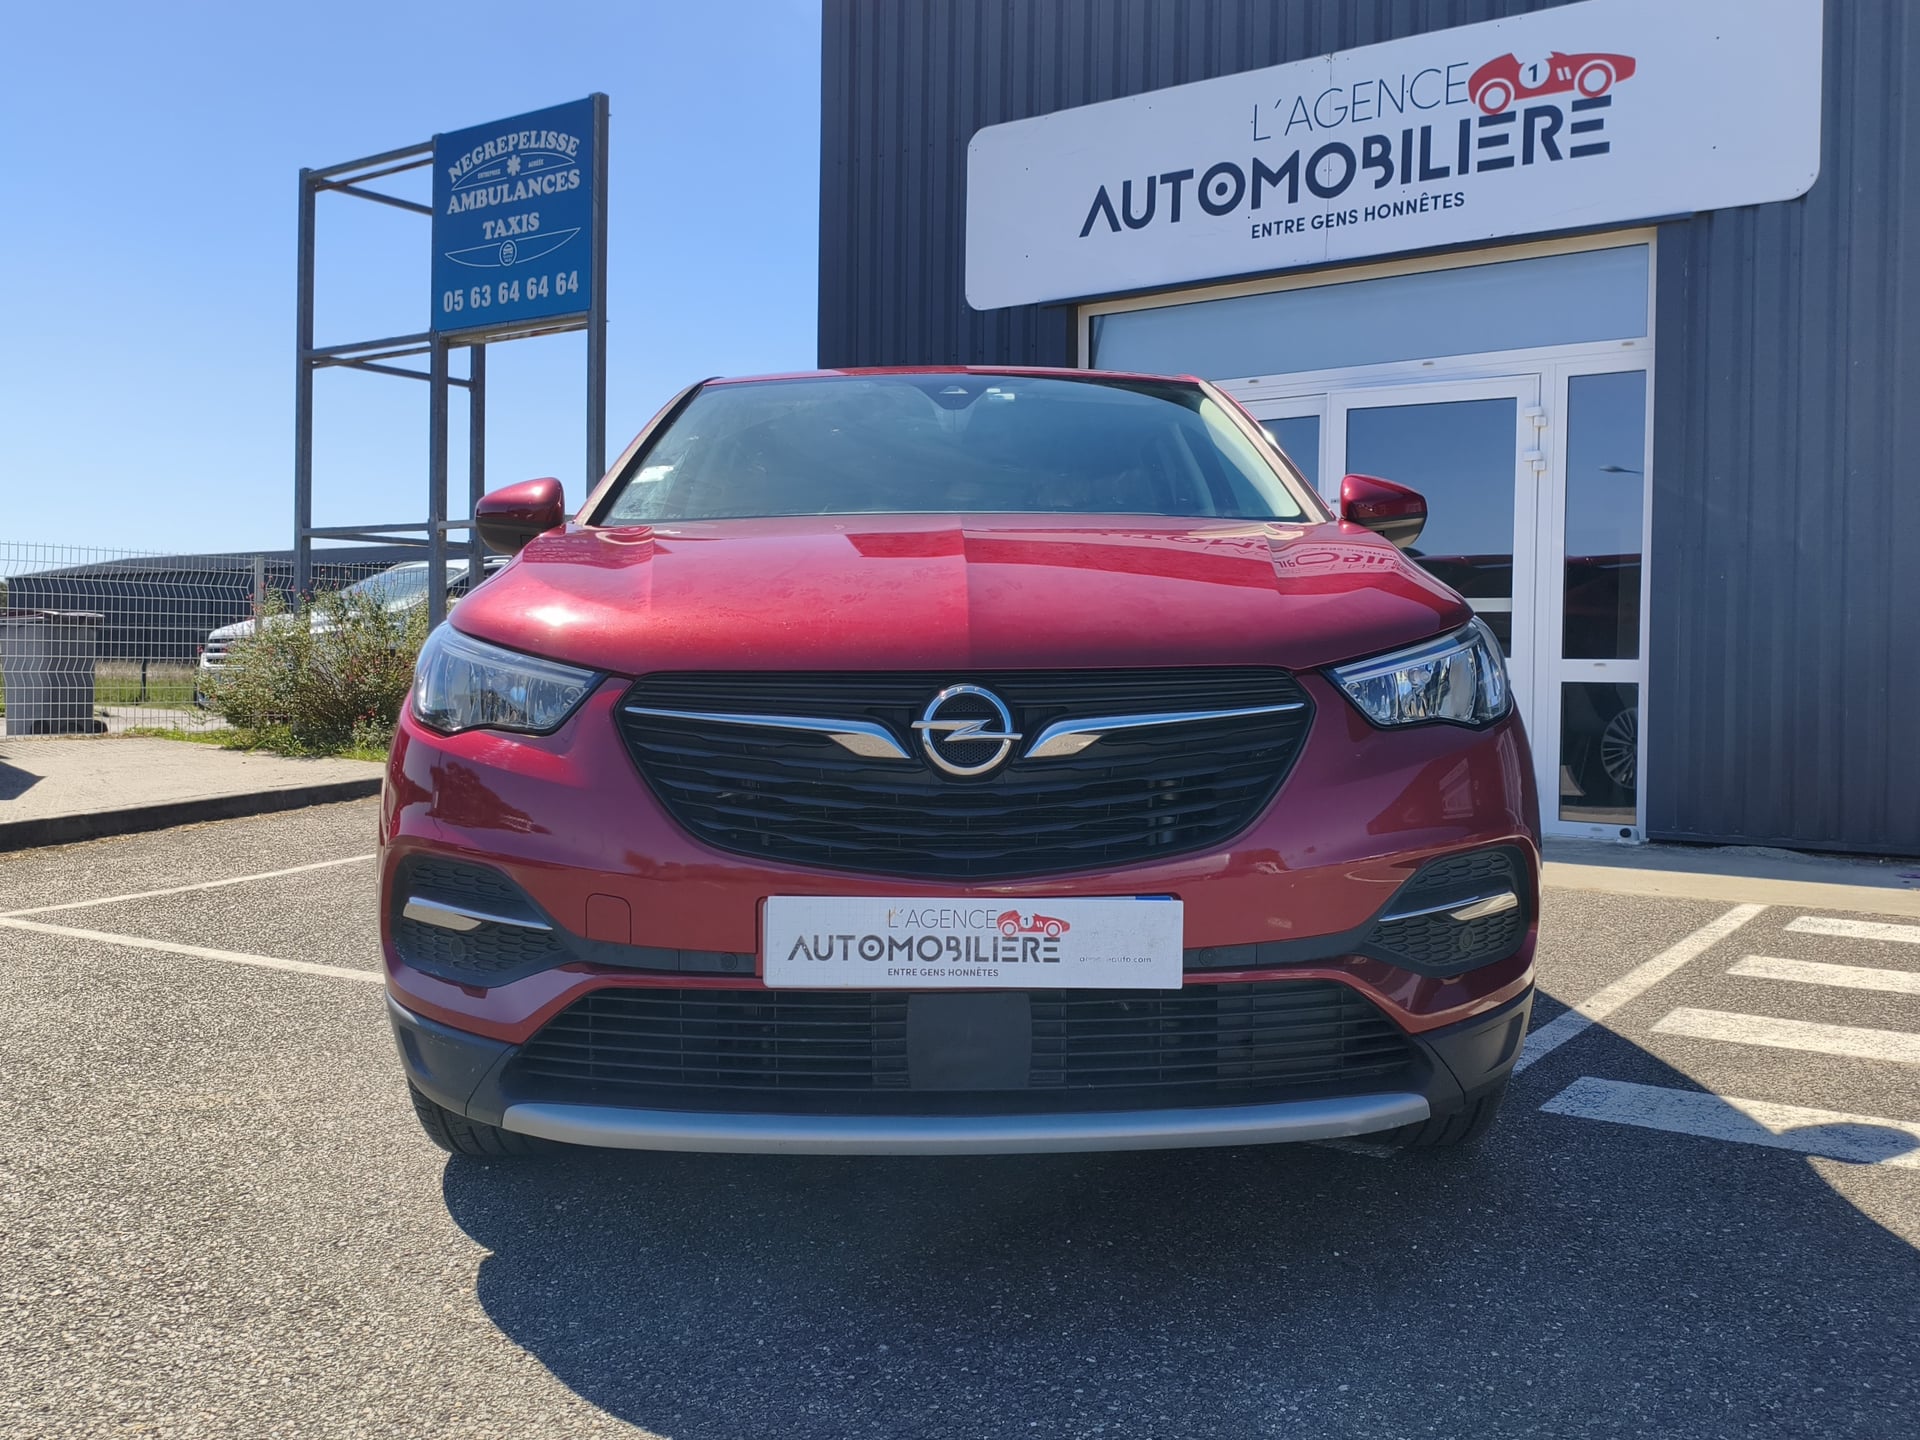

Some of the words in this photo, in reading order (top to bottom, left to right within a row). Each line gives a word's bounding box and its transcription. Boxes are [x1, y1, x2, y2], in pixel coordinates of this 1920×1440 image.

[1252, 62, 1471, 142] L'AGENCE
[447, 129, 581, 184] NEGREPELISSE
[1078, 94, 1613, 238] AUTOMOBILIERE
[446, 168, 581, 215] AMBULANCES
[482, 211, 541, 241] TAXIS
[1250, 217, 1306, 240] ENTRE
[1311, 208, 1359, 231] GENS
[1364, 191, 1466, 223] HONNÊTES
[443, 288, 464, 313] 05
[470, 284, 492, 309] 63
[498, 279, 520, 305] 64
[526, 275, 549, 300] 64
[555, 270, 579, 296] 64
[887, 908, 998, 929] L'AGENCE
[787, 934, 1061, 963] AUTOMOBILIERE
[887, 967, 918, 977] ENTRE
[920, 967, 946, 977] GENS
[948, 966, 999, 977] HONNÊTES
